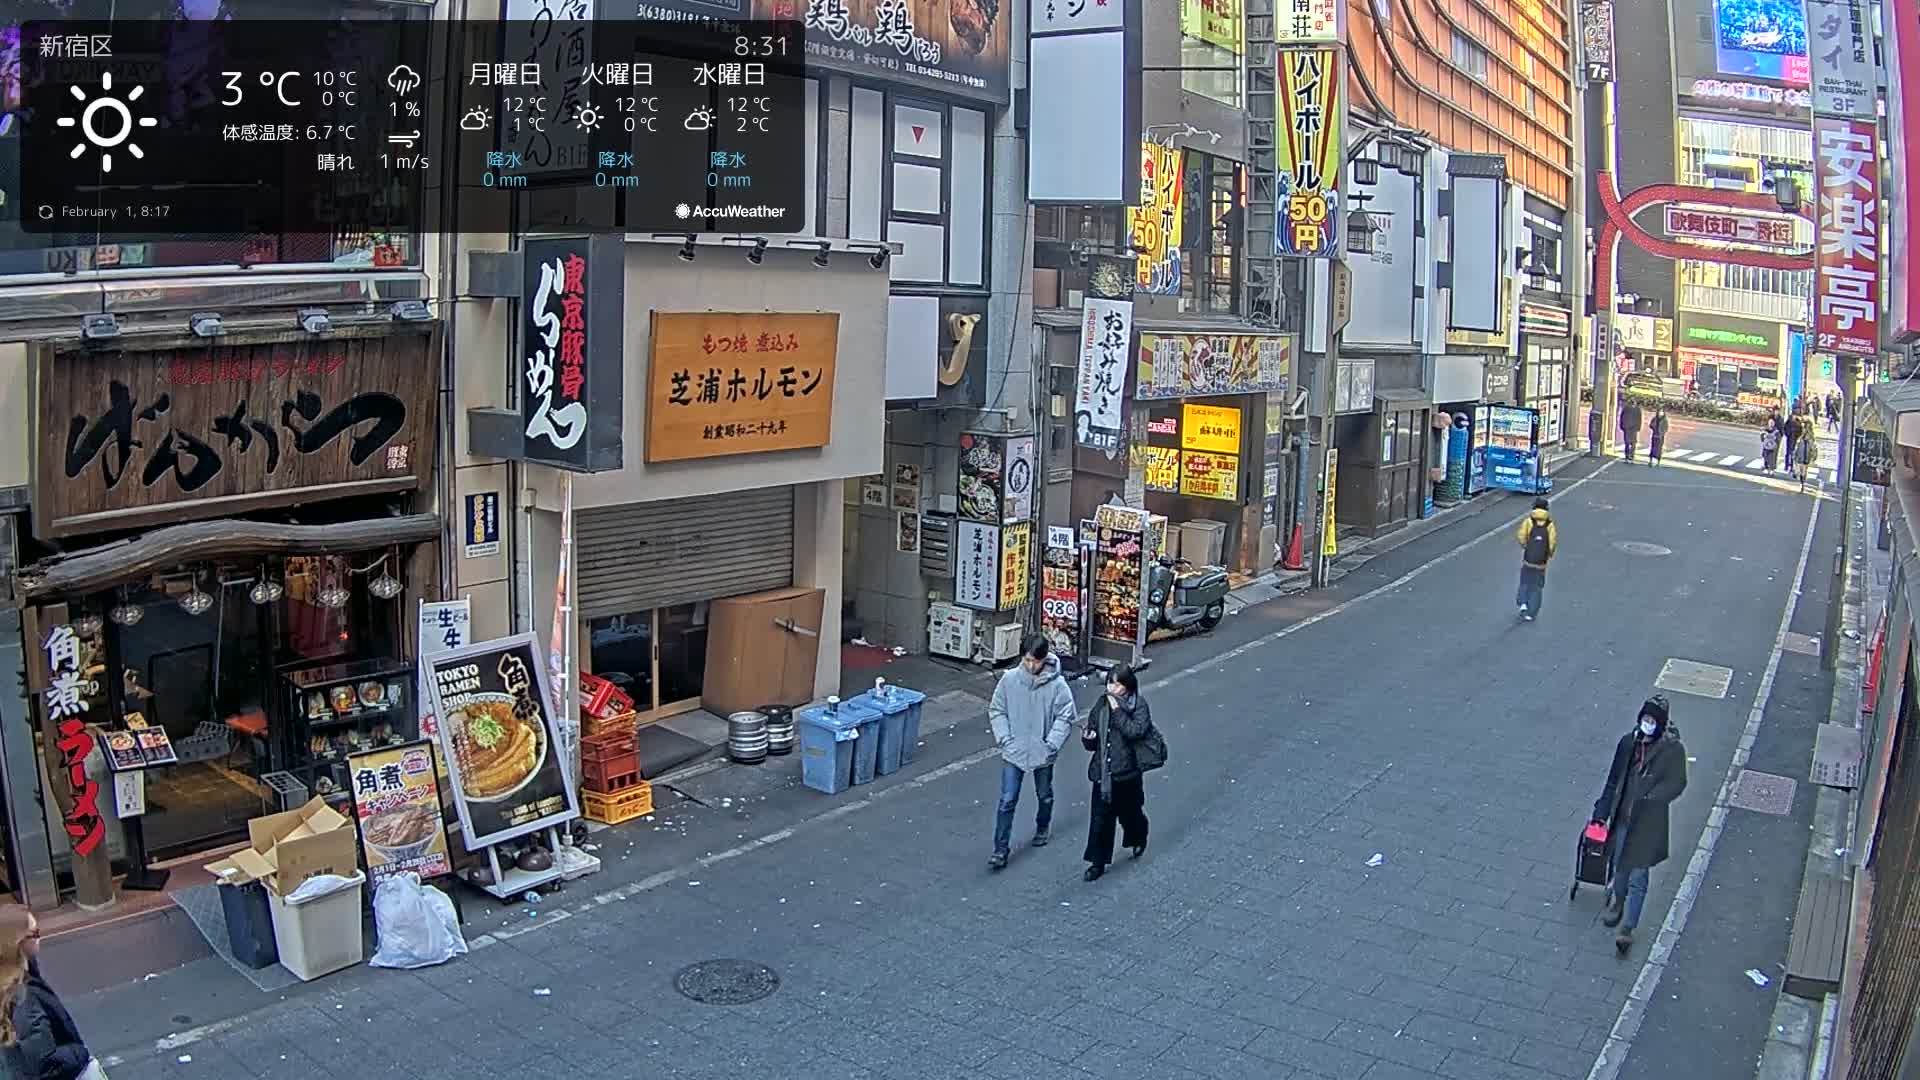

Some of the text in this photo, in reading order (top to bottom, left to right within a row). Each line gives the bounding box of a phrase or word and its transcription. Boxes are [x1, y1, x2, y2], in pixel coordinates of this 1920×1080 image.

[1589, 63, 1611, 80] 7F
[1832, 97, 1856, 112] 3F
[1294, 54, 1322, 191] ハイボール
[1161, 152, 1175, 289] ハイボール
[1289, 196, 1327, 222] 50
[1133, 219, 1156, 251] 50
[1295, 224, 1319, 251] 円
[1820, 126, 1876, 331] 安楽亭
[560, 253, 585, 401] 東京豚骨
[702, 331, 799, 355] もつ焼 煮込み
[1818, 333, 1837, 347] 2F
[668, 366, 823, 406] 芝浦ホルモン
[703, 420, 788, 440] 創業昭和二十九年
[1044, 600, 1077, 618] 980
[436, 664, 479, 685] TOKYO
[439, 677, 481, 696] RAMEN
[442, 692, 471, 708] SHOP
[355, 765, 404, 795] 角煮
